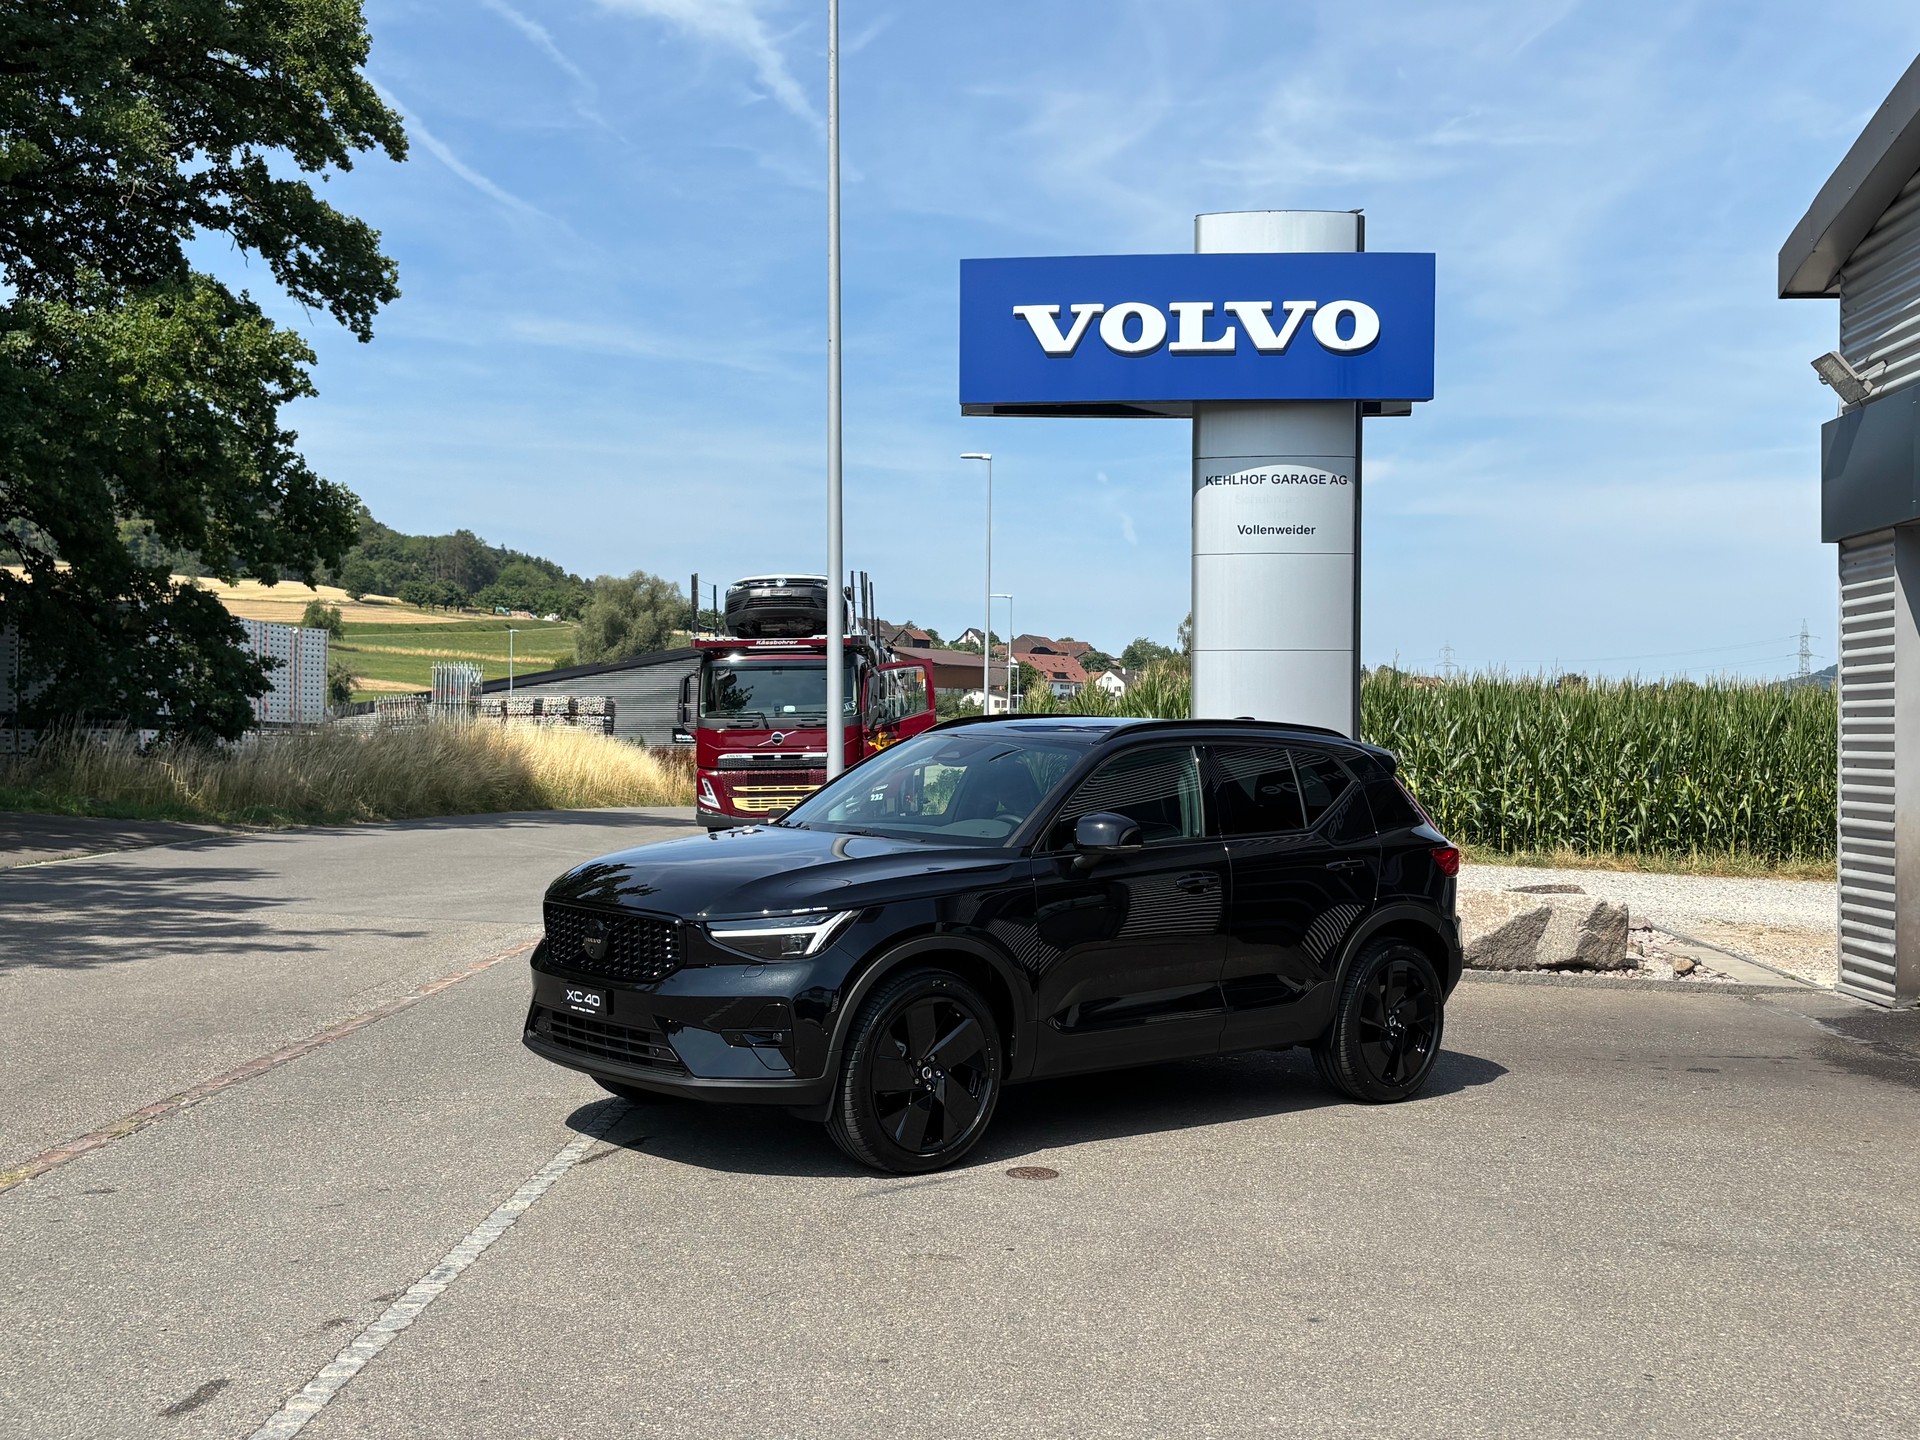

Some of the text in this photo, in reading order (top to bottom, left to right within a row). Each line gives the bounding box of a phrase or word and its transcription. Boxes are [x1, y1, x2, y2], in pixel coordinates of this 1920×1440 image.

[1013, 300, 1380, 354] VOLVO
[1205, 474, 1348, 486] KEHLHOF GARAGE AG
[1237, 524, 1316, 535] Vollenweider
[566, 989, 600, 1007] XC40
